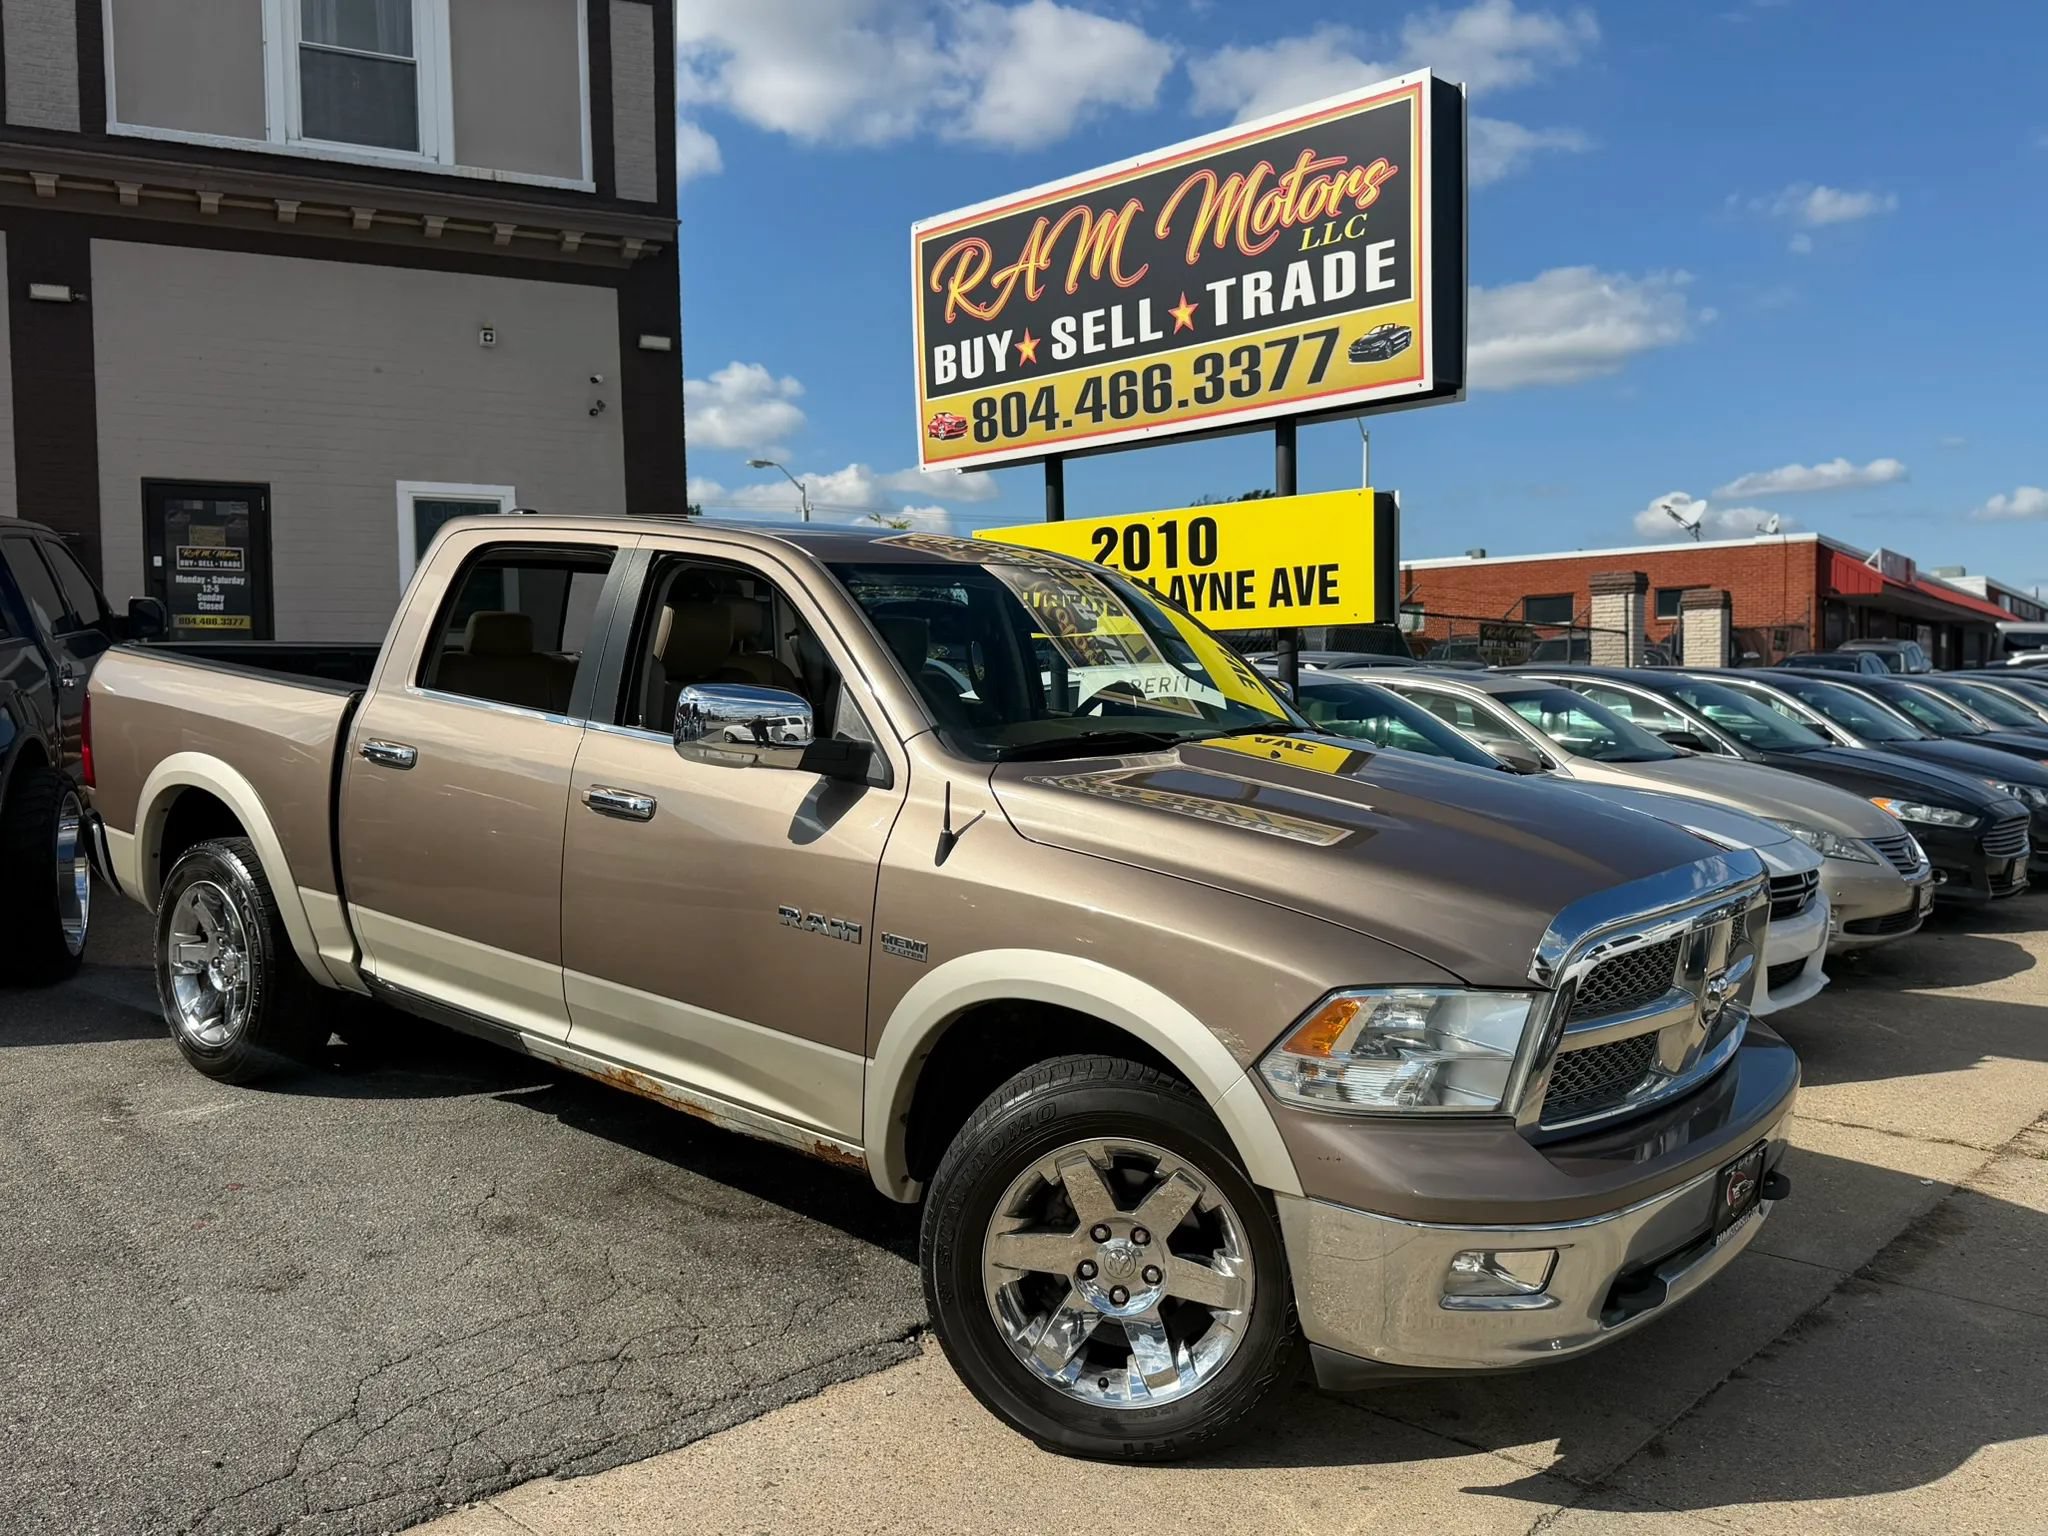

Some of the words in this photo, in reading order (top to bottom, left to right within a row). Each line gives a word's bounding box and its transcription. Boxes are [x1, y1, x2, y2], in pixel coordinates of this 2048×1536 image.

[1155, 147, 1398, 266] Motors
[1298, 213, 1367, 252] LLC
[933, 329, 1013, 386] BUY
[1050, 297, 1164, 361] SELL
[1206, 238, 1397, 326] TRADE
[972, 326, 1341, 444] 804.466.3377
[219, 560, 241, 568] TRADE
[1091, 516, 1218, 573] 2010
[175, 575, 206, 584] Monday
[211, 575, 245, 585] Saturday
[197, 593, 225, 602] Sunday
[1269, 563, 1340, 608] AVE
[198, 602, 224, 610] Closed
[778, 904, 862, 944] RAM
[881, 931, 928, 954] HEMI
